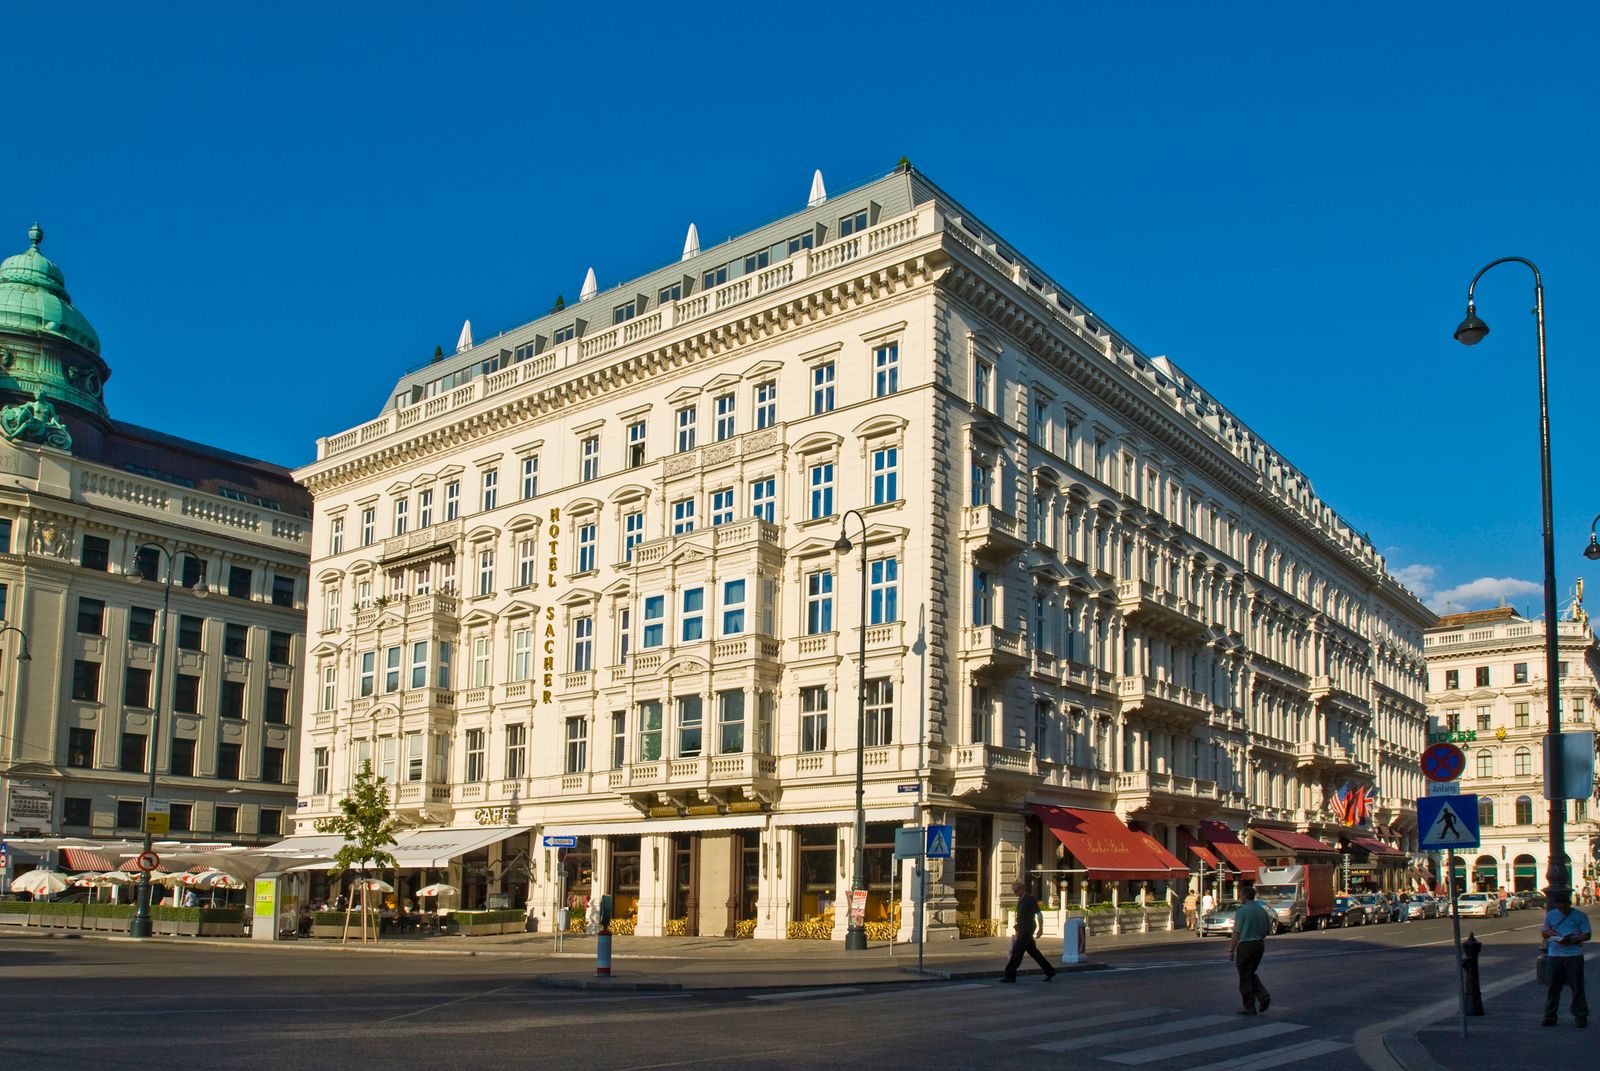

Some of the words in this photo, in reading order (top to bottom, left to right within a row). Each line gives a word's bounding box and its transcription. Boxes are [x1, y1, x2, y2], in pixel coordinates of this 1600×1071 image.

[547, 507, 560, 588] HOTEL
[542, 606, 556, 705] SACHER
[1429, 729, 1477, 742] ROLEX
[1432, 783, 1456, 794] Anfang
